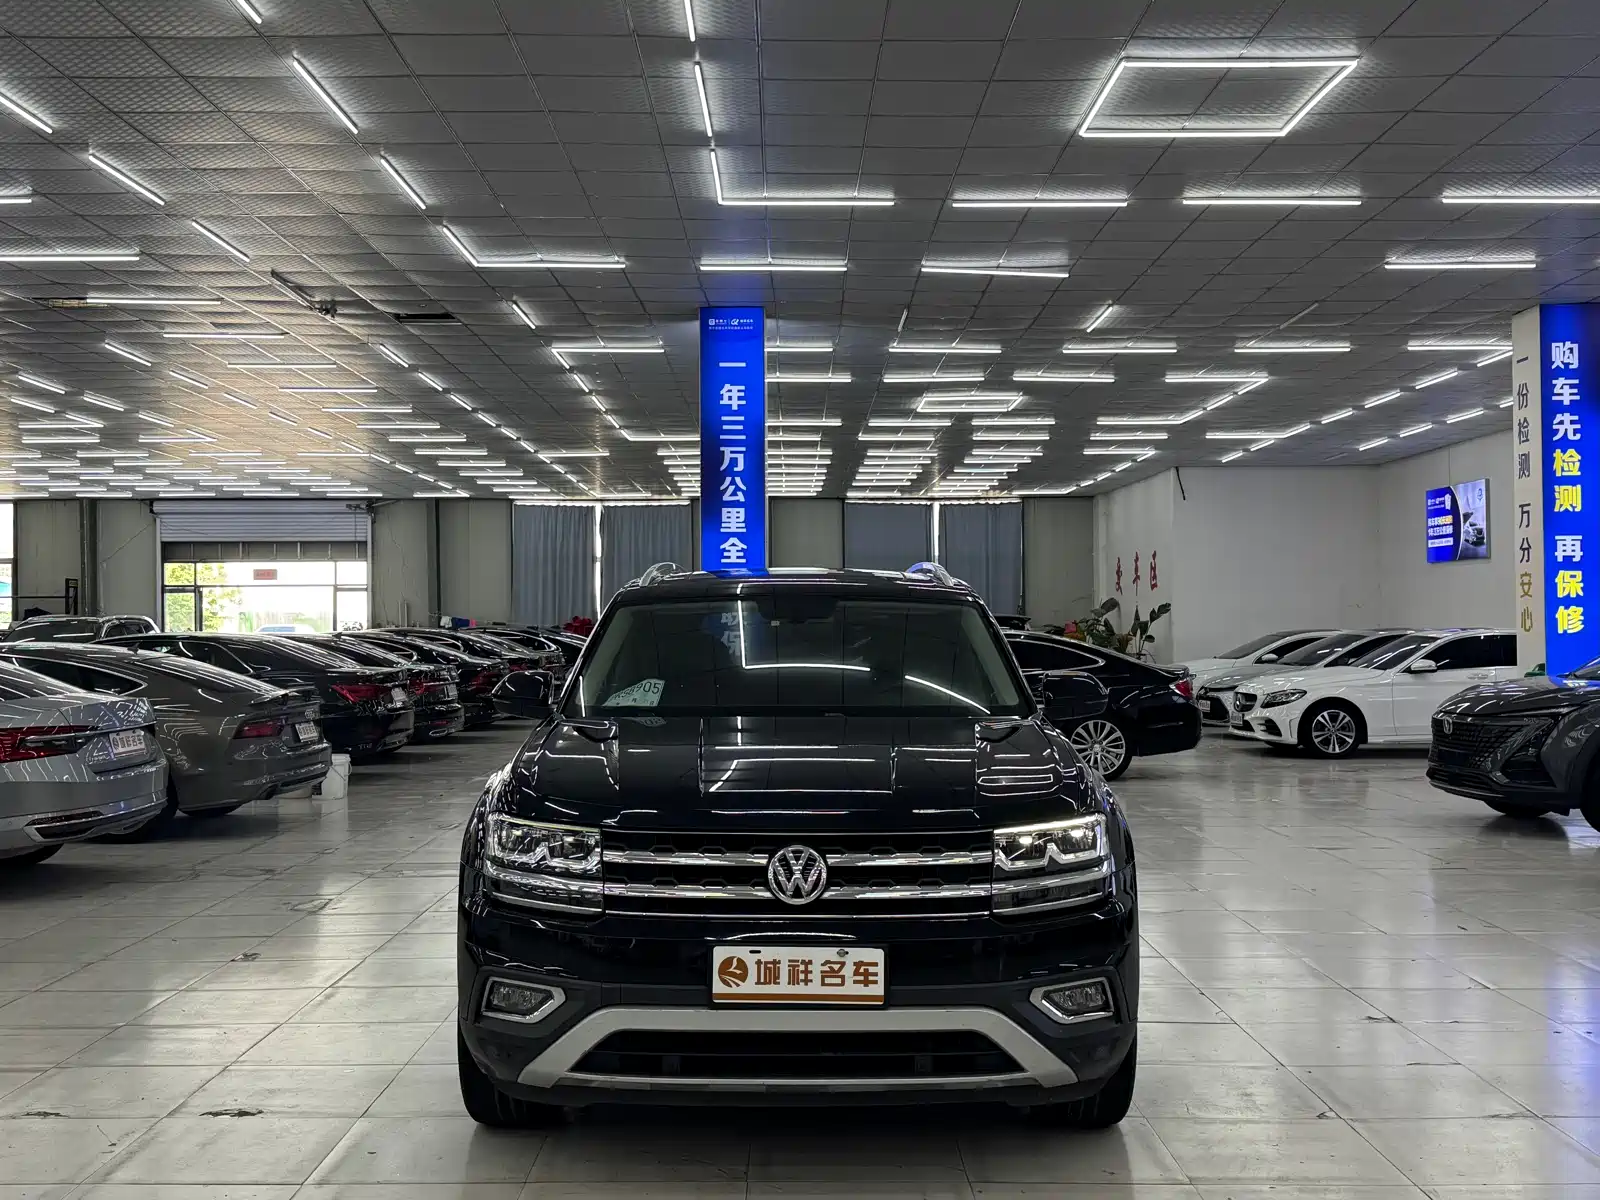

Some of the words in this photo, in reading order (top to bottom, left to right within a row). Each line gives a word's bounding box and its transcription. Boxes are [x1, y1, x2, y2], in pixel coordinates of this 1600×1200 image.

[718, 361, 748, 564] 一年三万公里全
[1516, 356, 1530, 480] 一份检测
[1551, 340, 1581, 512] 购车先检测
[1518, 502, 1534, 632] 万分安心
[1555, 535, 1585, 634] 再保修
[754, 958, 879, 988] 城祥名车
